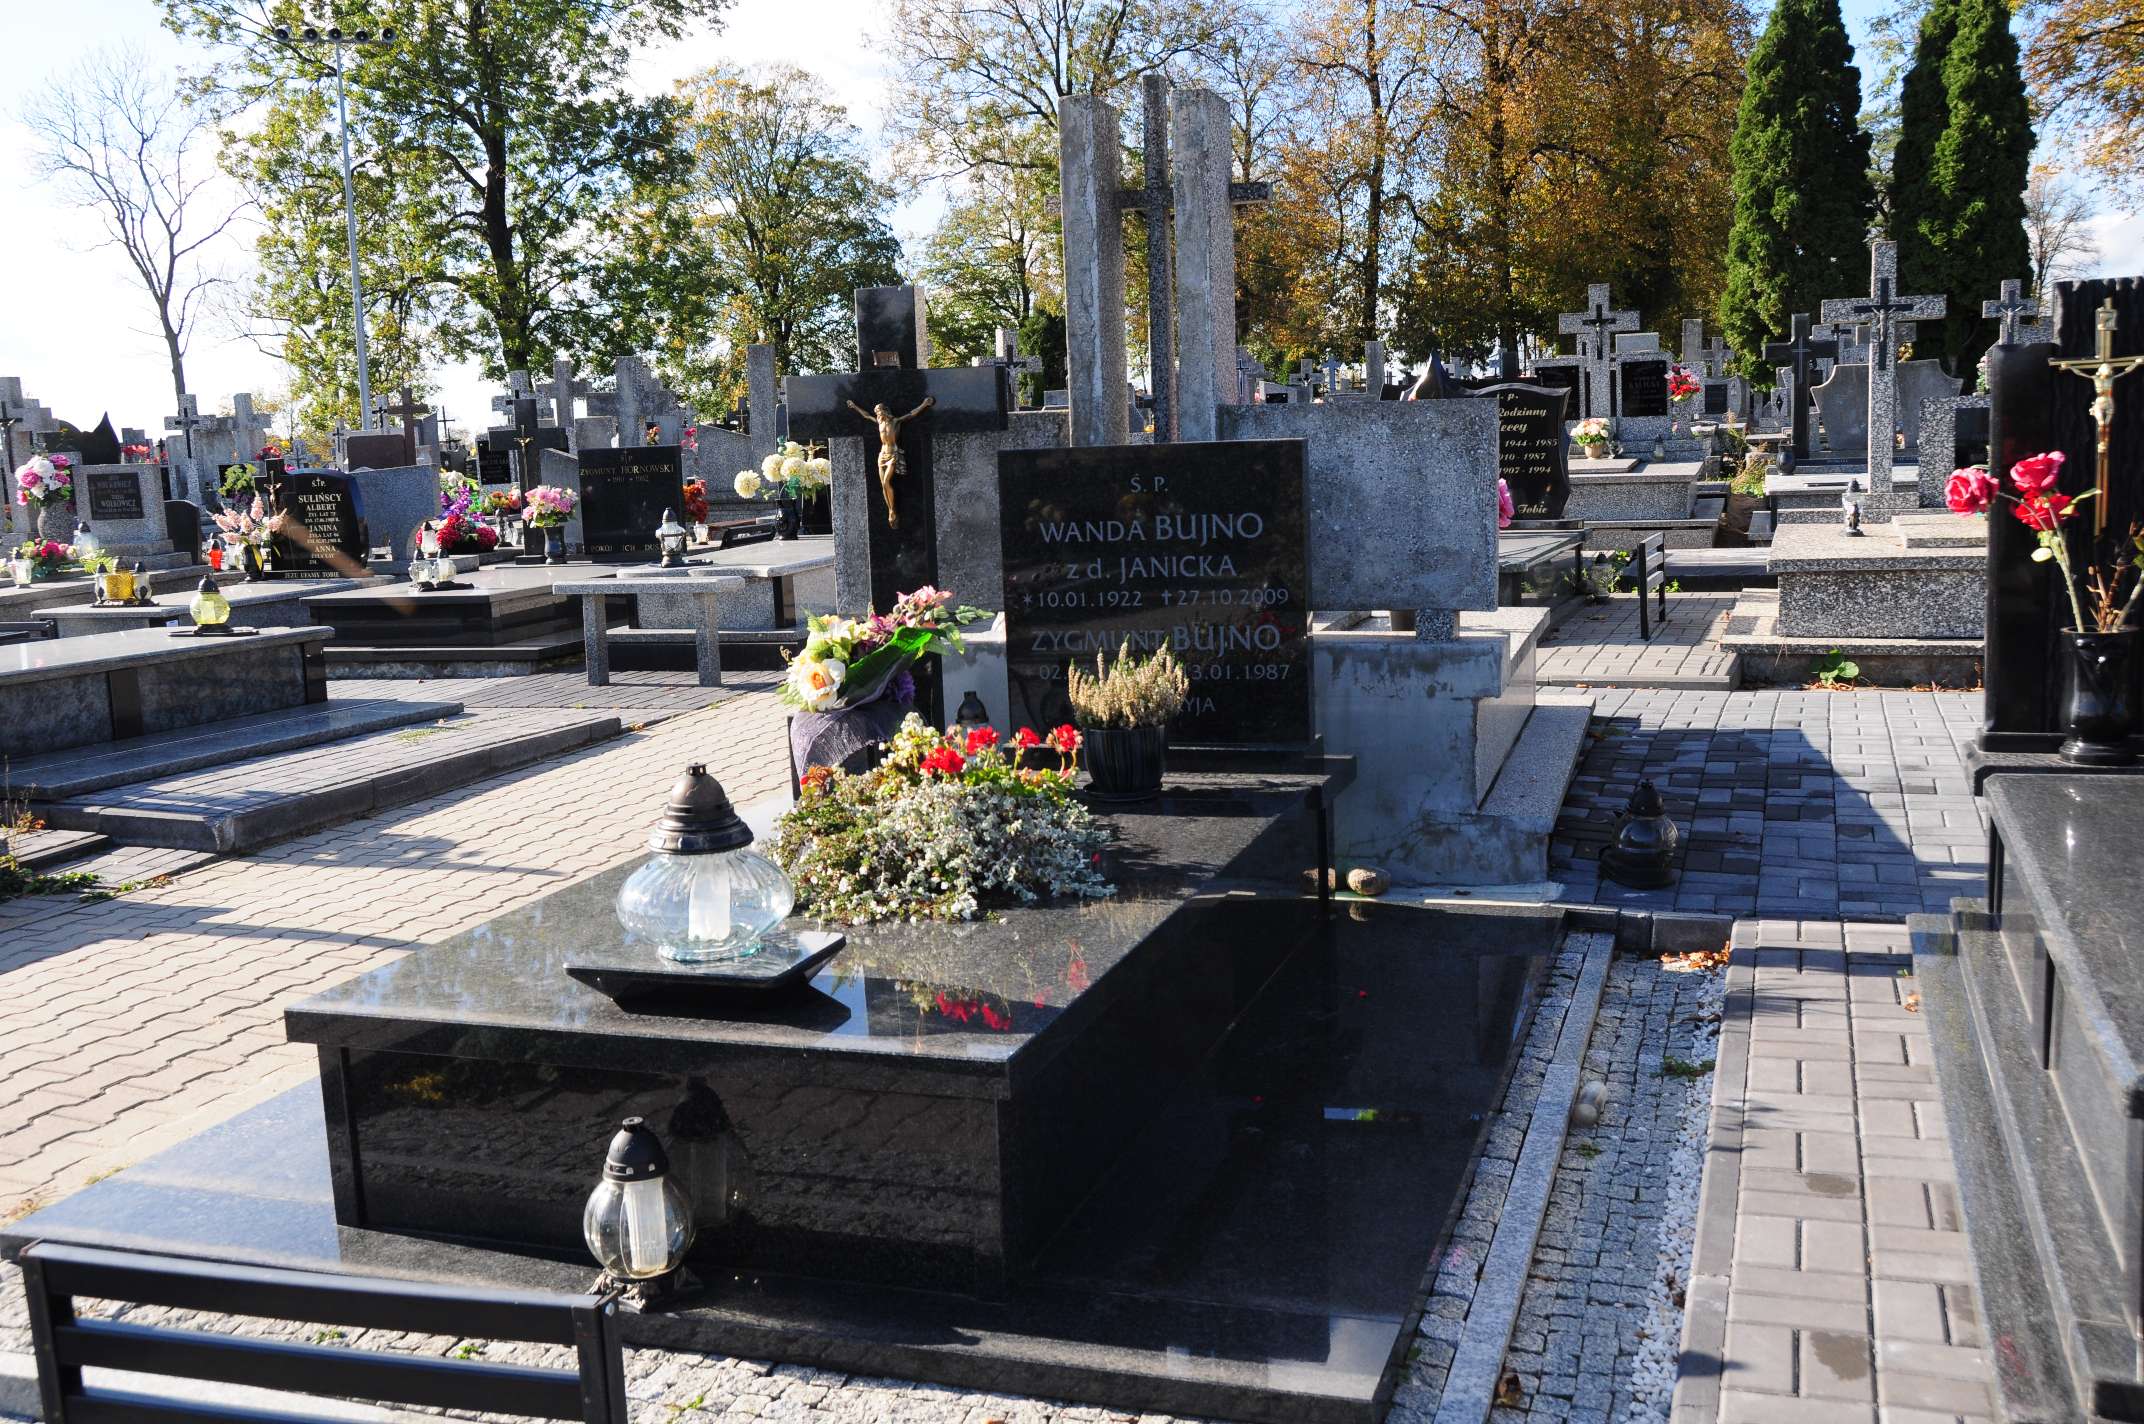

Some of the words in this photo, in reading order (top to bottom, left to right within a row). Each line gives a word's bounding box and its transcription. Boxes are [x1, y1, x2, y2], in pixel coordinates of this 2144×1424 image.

[621, 463, 674, 474] HORNOWSKI
[298, 492, 342, 503] SULIŃSCY
[306, 503, 337, 512] ALBERT
[1518, 501, 1548, 514] Tobie
[309, 524, 338, 533] JANINA
[1040, 519, 1146, 543] WANDA
[1155, 512, 1264, 547] BUJNO
[314, 545, 337, 553] ANNA
[1119, 554, 1238, 584] JANICKA
[1031, 628, 1167, 651] ZYGMUNT
[1173, 624, 1282, 657] BUJNO
